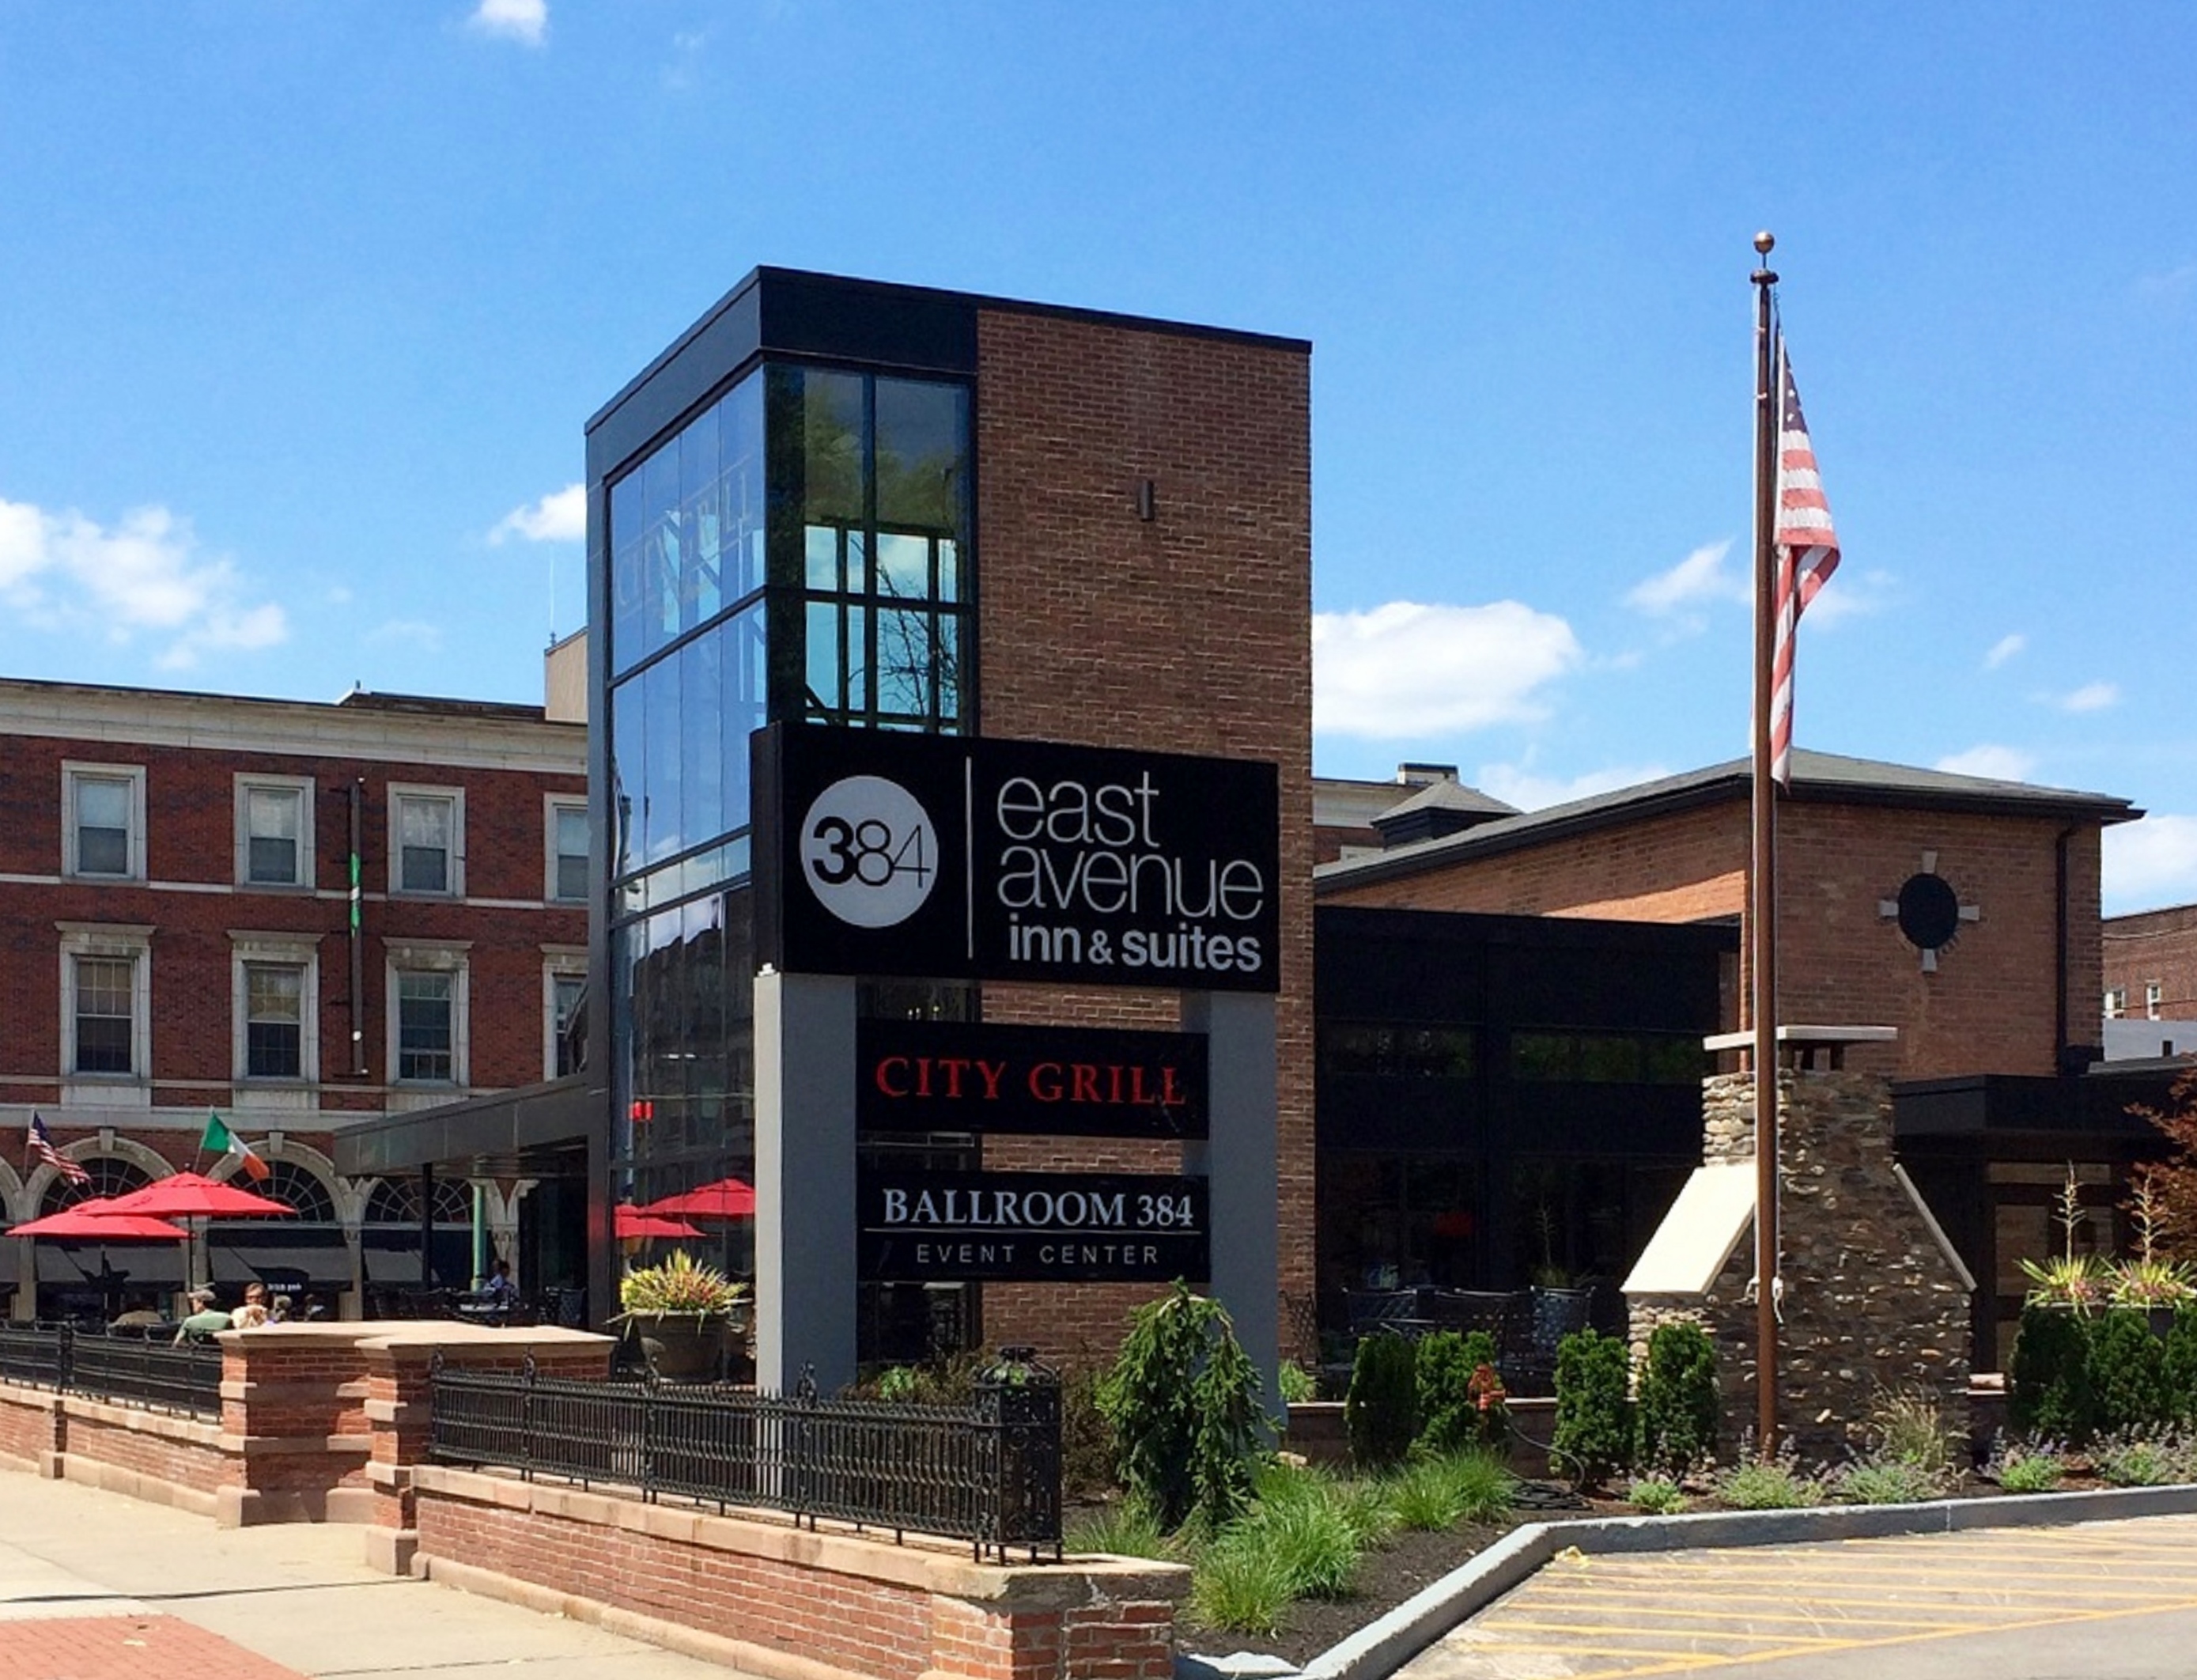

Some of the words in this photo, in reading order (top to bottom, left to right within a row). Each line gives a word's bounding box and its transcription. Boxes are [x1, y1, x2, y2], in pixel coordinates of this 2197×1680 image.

[996, 770, 1161, 848] east
[811, 815, 932, 889] 384
[997, 845, 1264, 921] avenue
[1009, 913, 1080, 963] inn
[1088, 929, 1114, 965] &
[1121, 921, 1261, 972] suites
[875, 1056, 1007, 1099] CITY
[1027, 1061, 1186, 1106] GRILL
[882, 1188, 1126, 1227] BALLROOM
[1136, 1194, 1193, 1227] 384
[917, 1244, 1016, 1264] EVENT
[1038, 1245, 1159, 1265] CENTER
